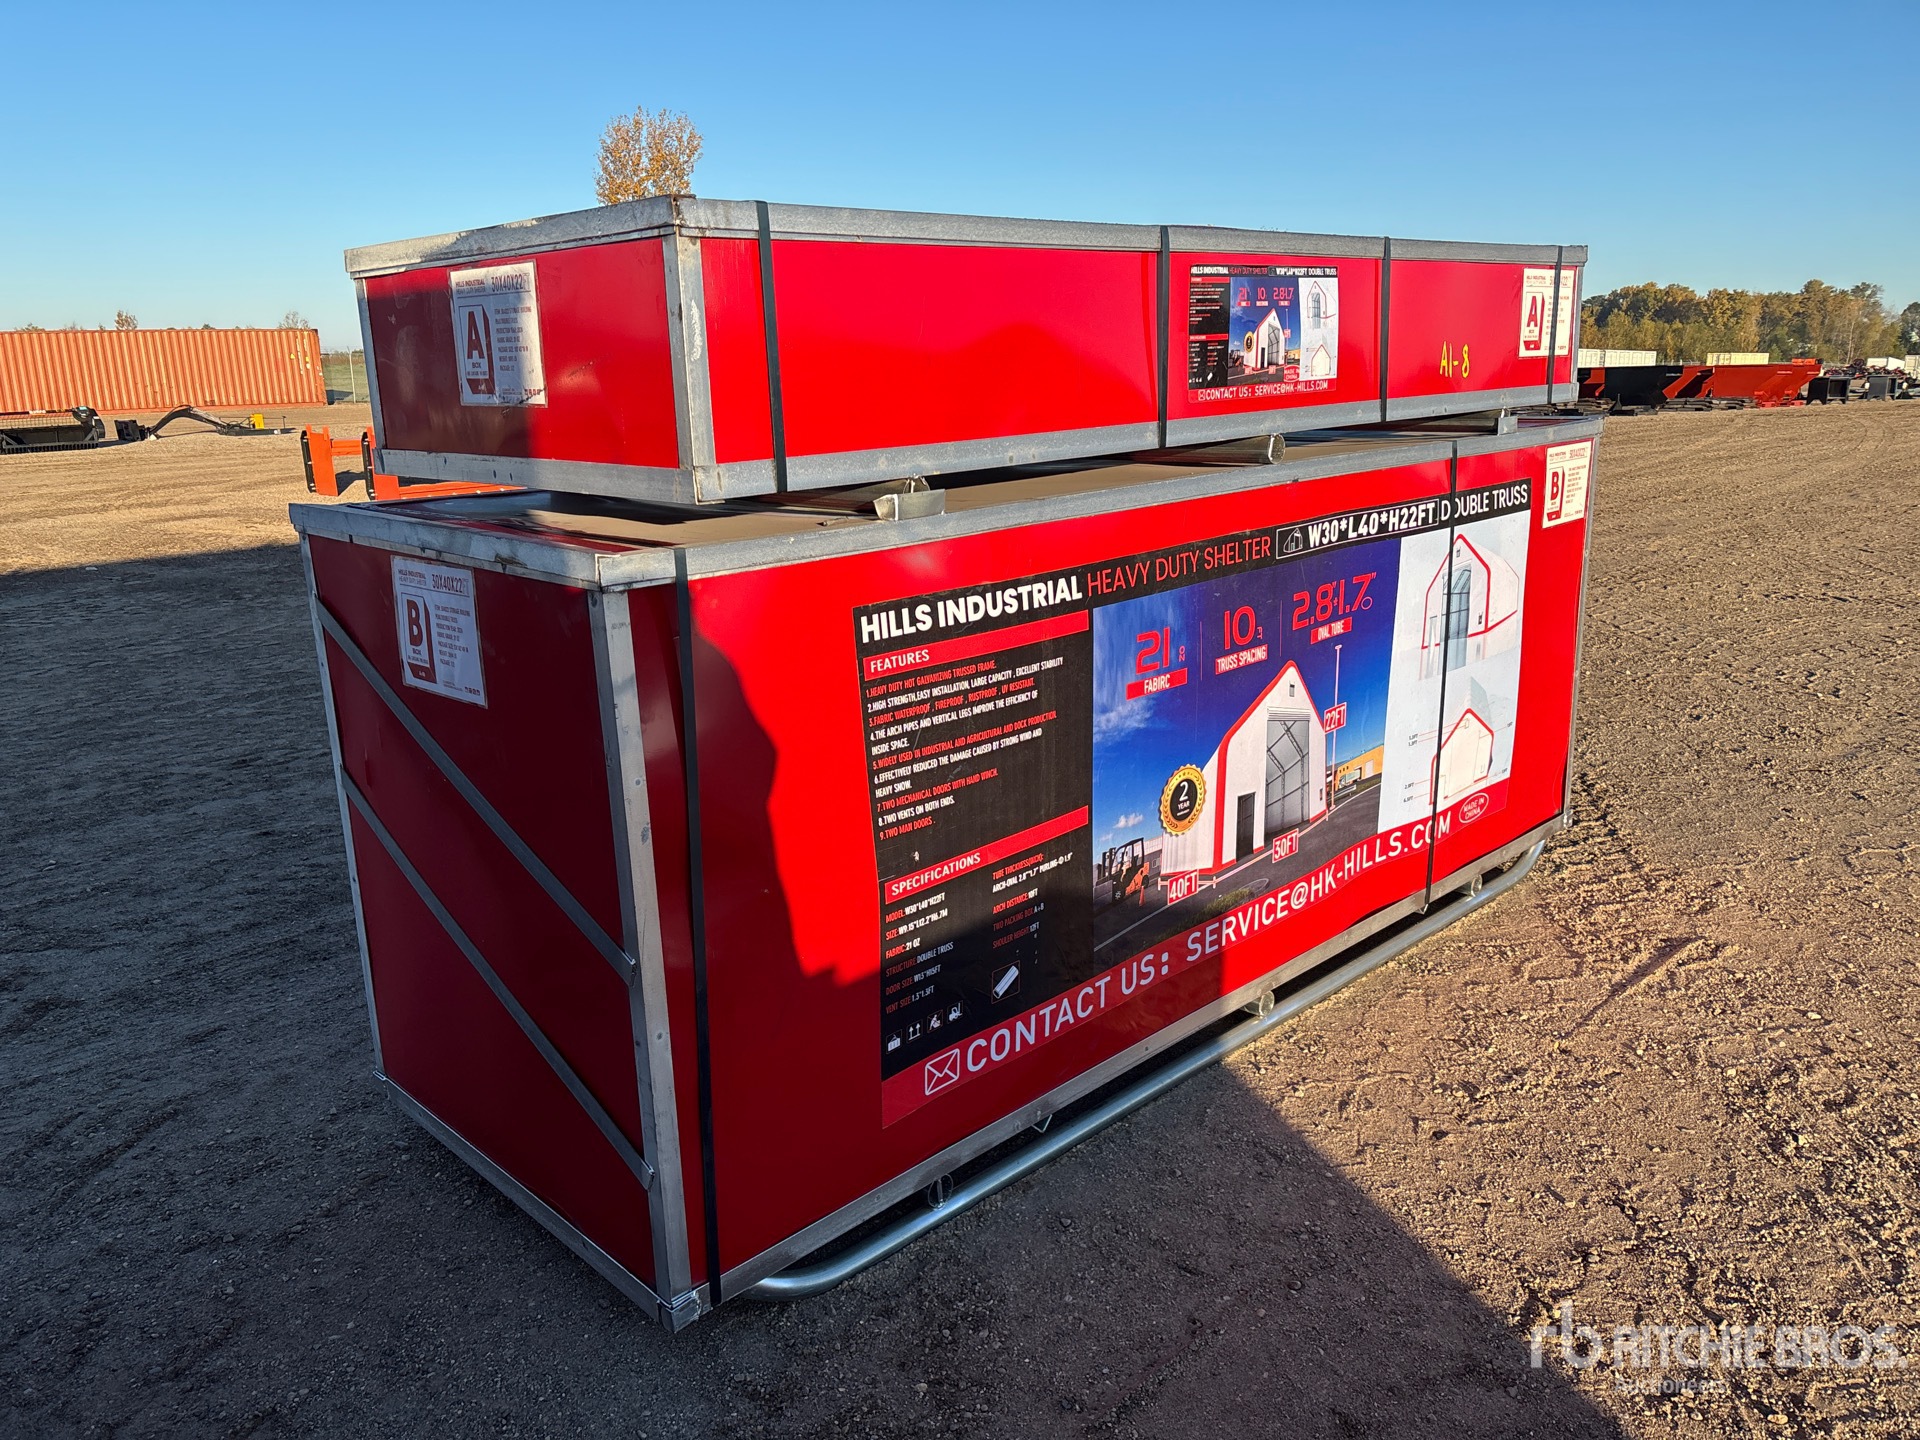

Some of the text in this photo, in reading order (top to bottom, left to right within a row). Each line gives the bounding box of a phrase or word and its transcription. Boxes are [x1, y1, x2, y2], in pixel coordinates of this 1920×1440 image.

[1257, 287, 1266, 300] 10
[1526, 295, 1538, 328] A
[467, 311, 485, 359] A
[1204, 380, 1328, 400] CONTACT US: SERVICE@HK-HILLS.COM
[1550, 471, 1560, 501] B
[860, 603, 933, 643] HILLS
[937, 575, 1083, 628] INDUSTRIAL
[1087, 560, 1151, 597] HEAVY
[1155, 550, 1199, 581] DUTY
[1204, 536, 1271, 570] SHELTER
[1492, 484, 1528, 509] TRUSS
[406, 599, 423, 646] B
[1223, 605, 1257, 650] 10
[1317, 621, 1345, 641] OVAL TUBE
[870, 649, 930, 673] FEATURES
[1135, 627, 1171, 675] 21
[1217, 646, 1267, 672] TRUSS SPACING
[888, 681, 903, 692] DUTY
[904, 678, 915, 689] HOT
[916, 670, 952, 686] GALVANIZING
[953, 665, 976, 678] TRUSSED
[970, 676, 987, 688] LARGE
[988, 670, 1012, 684] CAPACITY
[1015, 662, 1040, 677] EXCELLENT
[1040, 656, 1064, 671] STABILITY
[1143, 674, 1171, 695] FABIRC
[886, 726, 902, 738] ARCH
[903, 720, 919, 732] PIPES
[919, 717, 932, 729] AND
[931, 710, 958, 726] VERTICAL
[958, 706, 972, 719] LEGS
[972, 701, 995, 715] IMPROVE
[995, 698, 1005, 709] THE
[1005, 691, 1031, 707] EFFICIENCY
[1031, 689, 1039, 700] OF
[894, 702, 931, 720] WATERPROOF
[935, 695, 964, 711] FIREPROOF
[968, 686, 998, 702] RUSTPROOF
[1001, 684, 1009, 694] UV
[1325, 707, 1346, 731] 22FT
[871, 743, 890, 756] INSIDE
[898, 751, 913, 762] USED
[914, 748, 921, 758] IN
[921, 740, 954, 757] INDUSTRIAL
[954, 736, 966, 748] AND
[966, 726, 1003, 743] AGRICULTURAL
[1003, 723, 1014, 734] AND
[912, 758, 938, 773] REDUCED
[938, 755, 949, 766] THE
[949, 749, 972, 763] DAMAGE
[972, 743, 992, 757] CAUSED
[992, 740, 1000, 751] BY
[1000, 735, 1020, 748] STRONG
[1019, 730, 1033, 742] WIND
[1032, 727, 1043, 738] AND
[875, 785, 893, 798] HEAVY
[896, 788, 932, 806] MECHANICAL
[932, 783, 952, 796] DOORS
[951, 778, 966, 790] WITH
[966, 773, 981, 786] HAND
[1179, 781, 1189, 802] 2
[896, 807, 915, 820] VENTS
[915, 805, 924, 815] ON
[924, 800, 940, 812] BOTH
[1177, 800, 1190, 810] YEAR
[1463, 797, 1485, 813] MADE IN
[1465, 806, 1481, 820] CHINA
[899, 822, 913, 834] MAN
[1273, 832, 1298, 860] 30FT
[891, 852, 981, 897] SPECIFICATIONS
[992, 868, 1005, 880] TUBE
[1169, 873, 1197, 901] 40FT
[992, 902, 1006, 915] ARCH
[992, 920, 1004, 931] TWO
[1004, 911, 1024, 927] PACKING
[937, 941, 954, 956] TRUSS
[966, 811, 1451, 1074] CONTACT US: SERVICE@HK-HILLS.COM
[885, 982, 901, 996] DOOR
[885, 1001, 899, 1015] VENT
